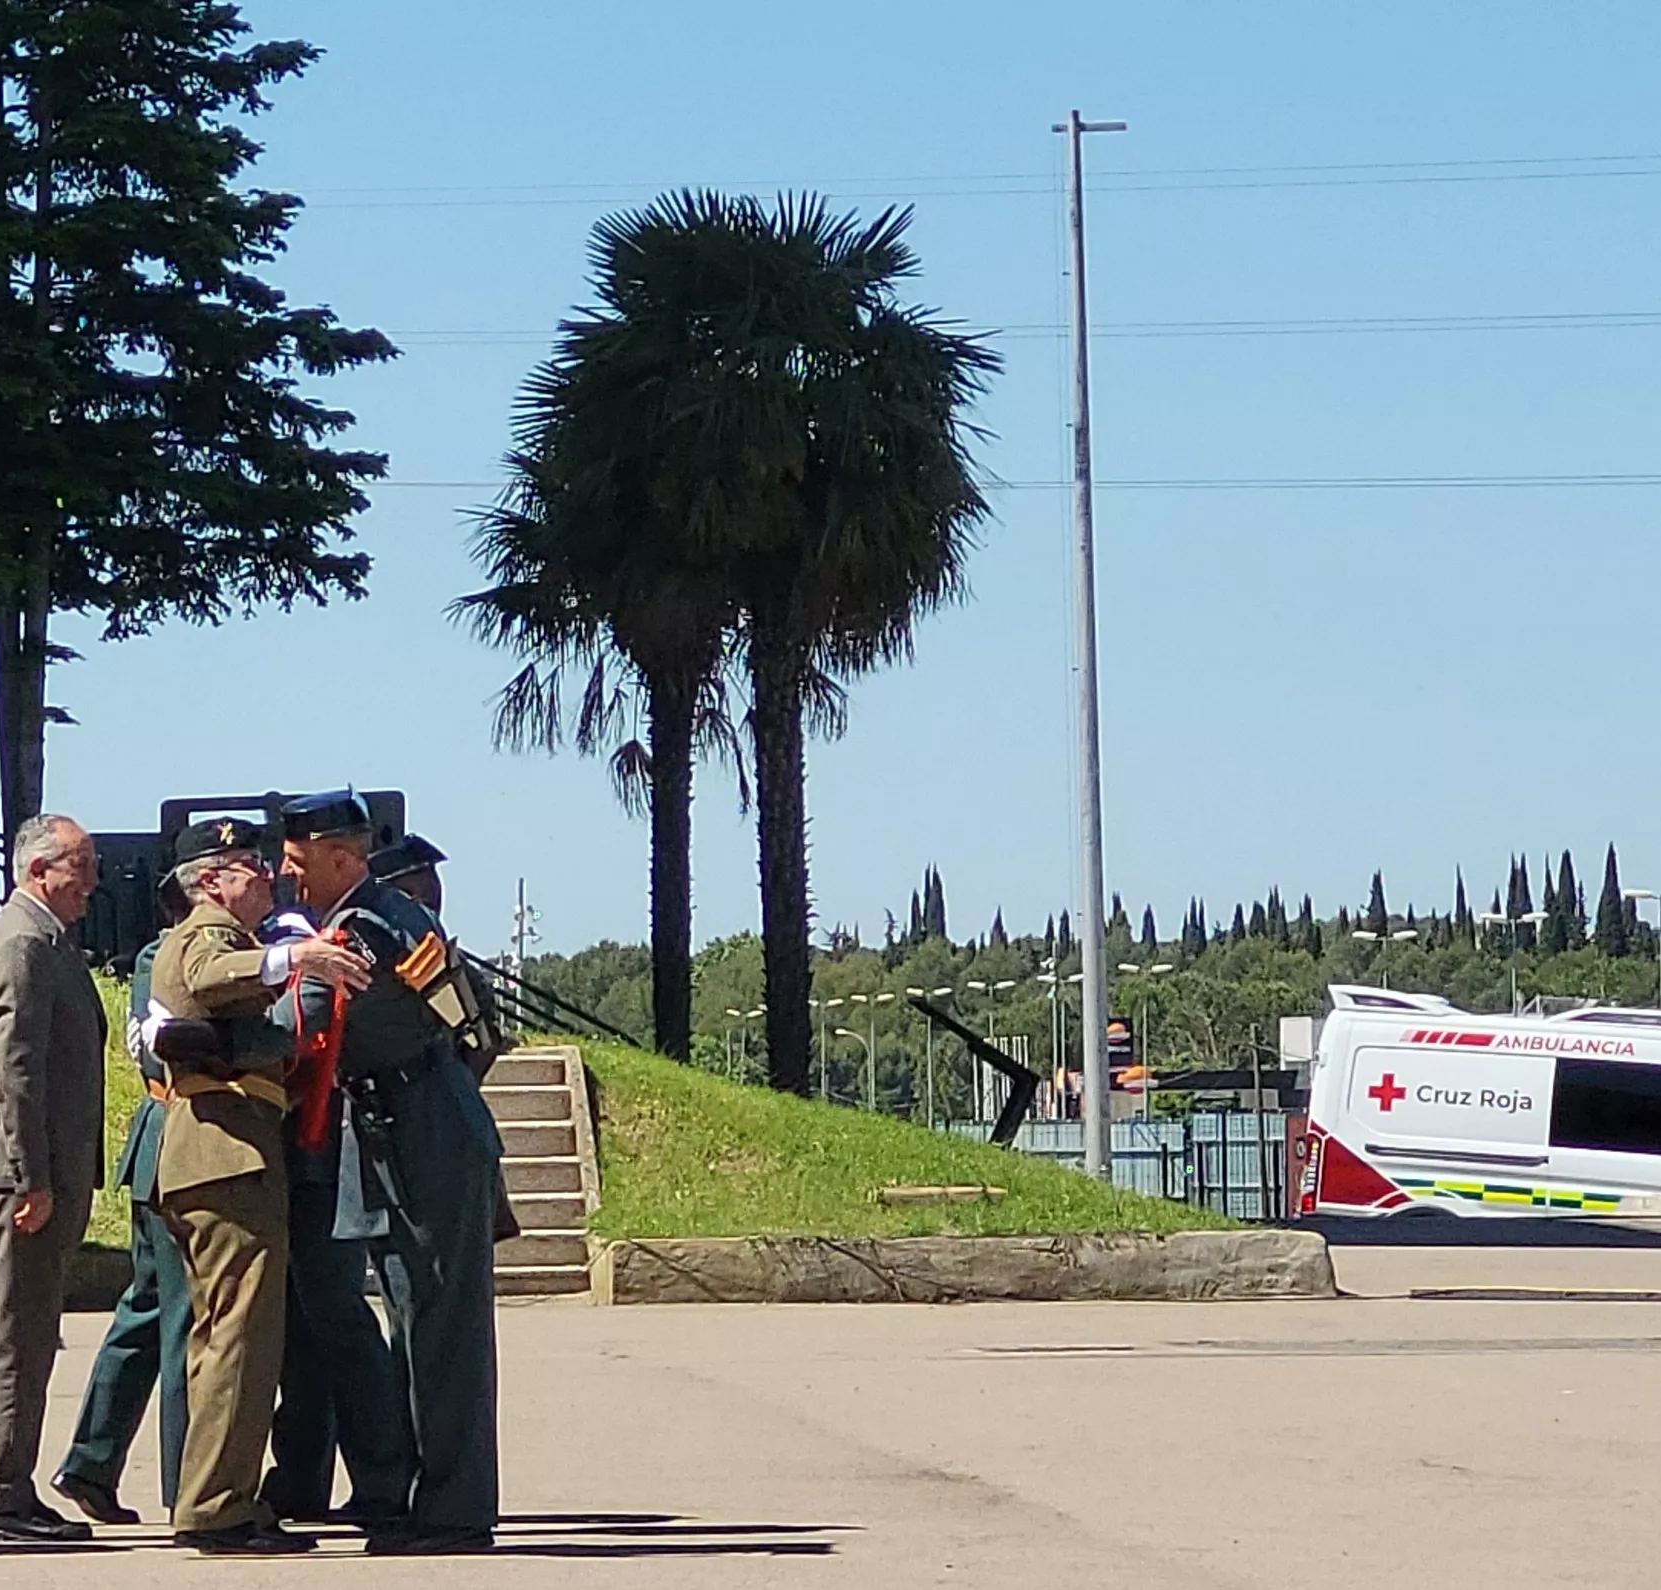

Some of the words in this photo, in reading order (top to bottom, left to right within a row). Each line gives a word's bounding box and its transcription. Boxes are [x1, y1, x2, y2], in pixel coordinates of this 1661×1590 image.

[1495, 1034, 1635, 1057] AMBULANCIA
[1416, 1085, 1473, 1106] Cruz
[1480, 1089, 1533, 1114] Roja
